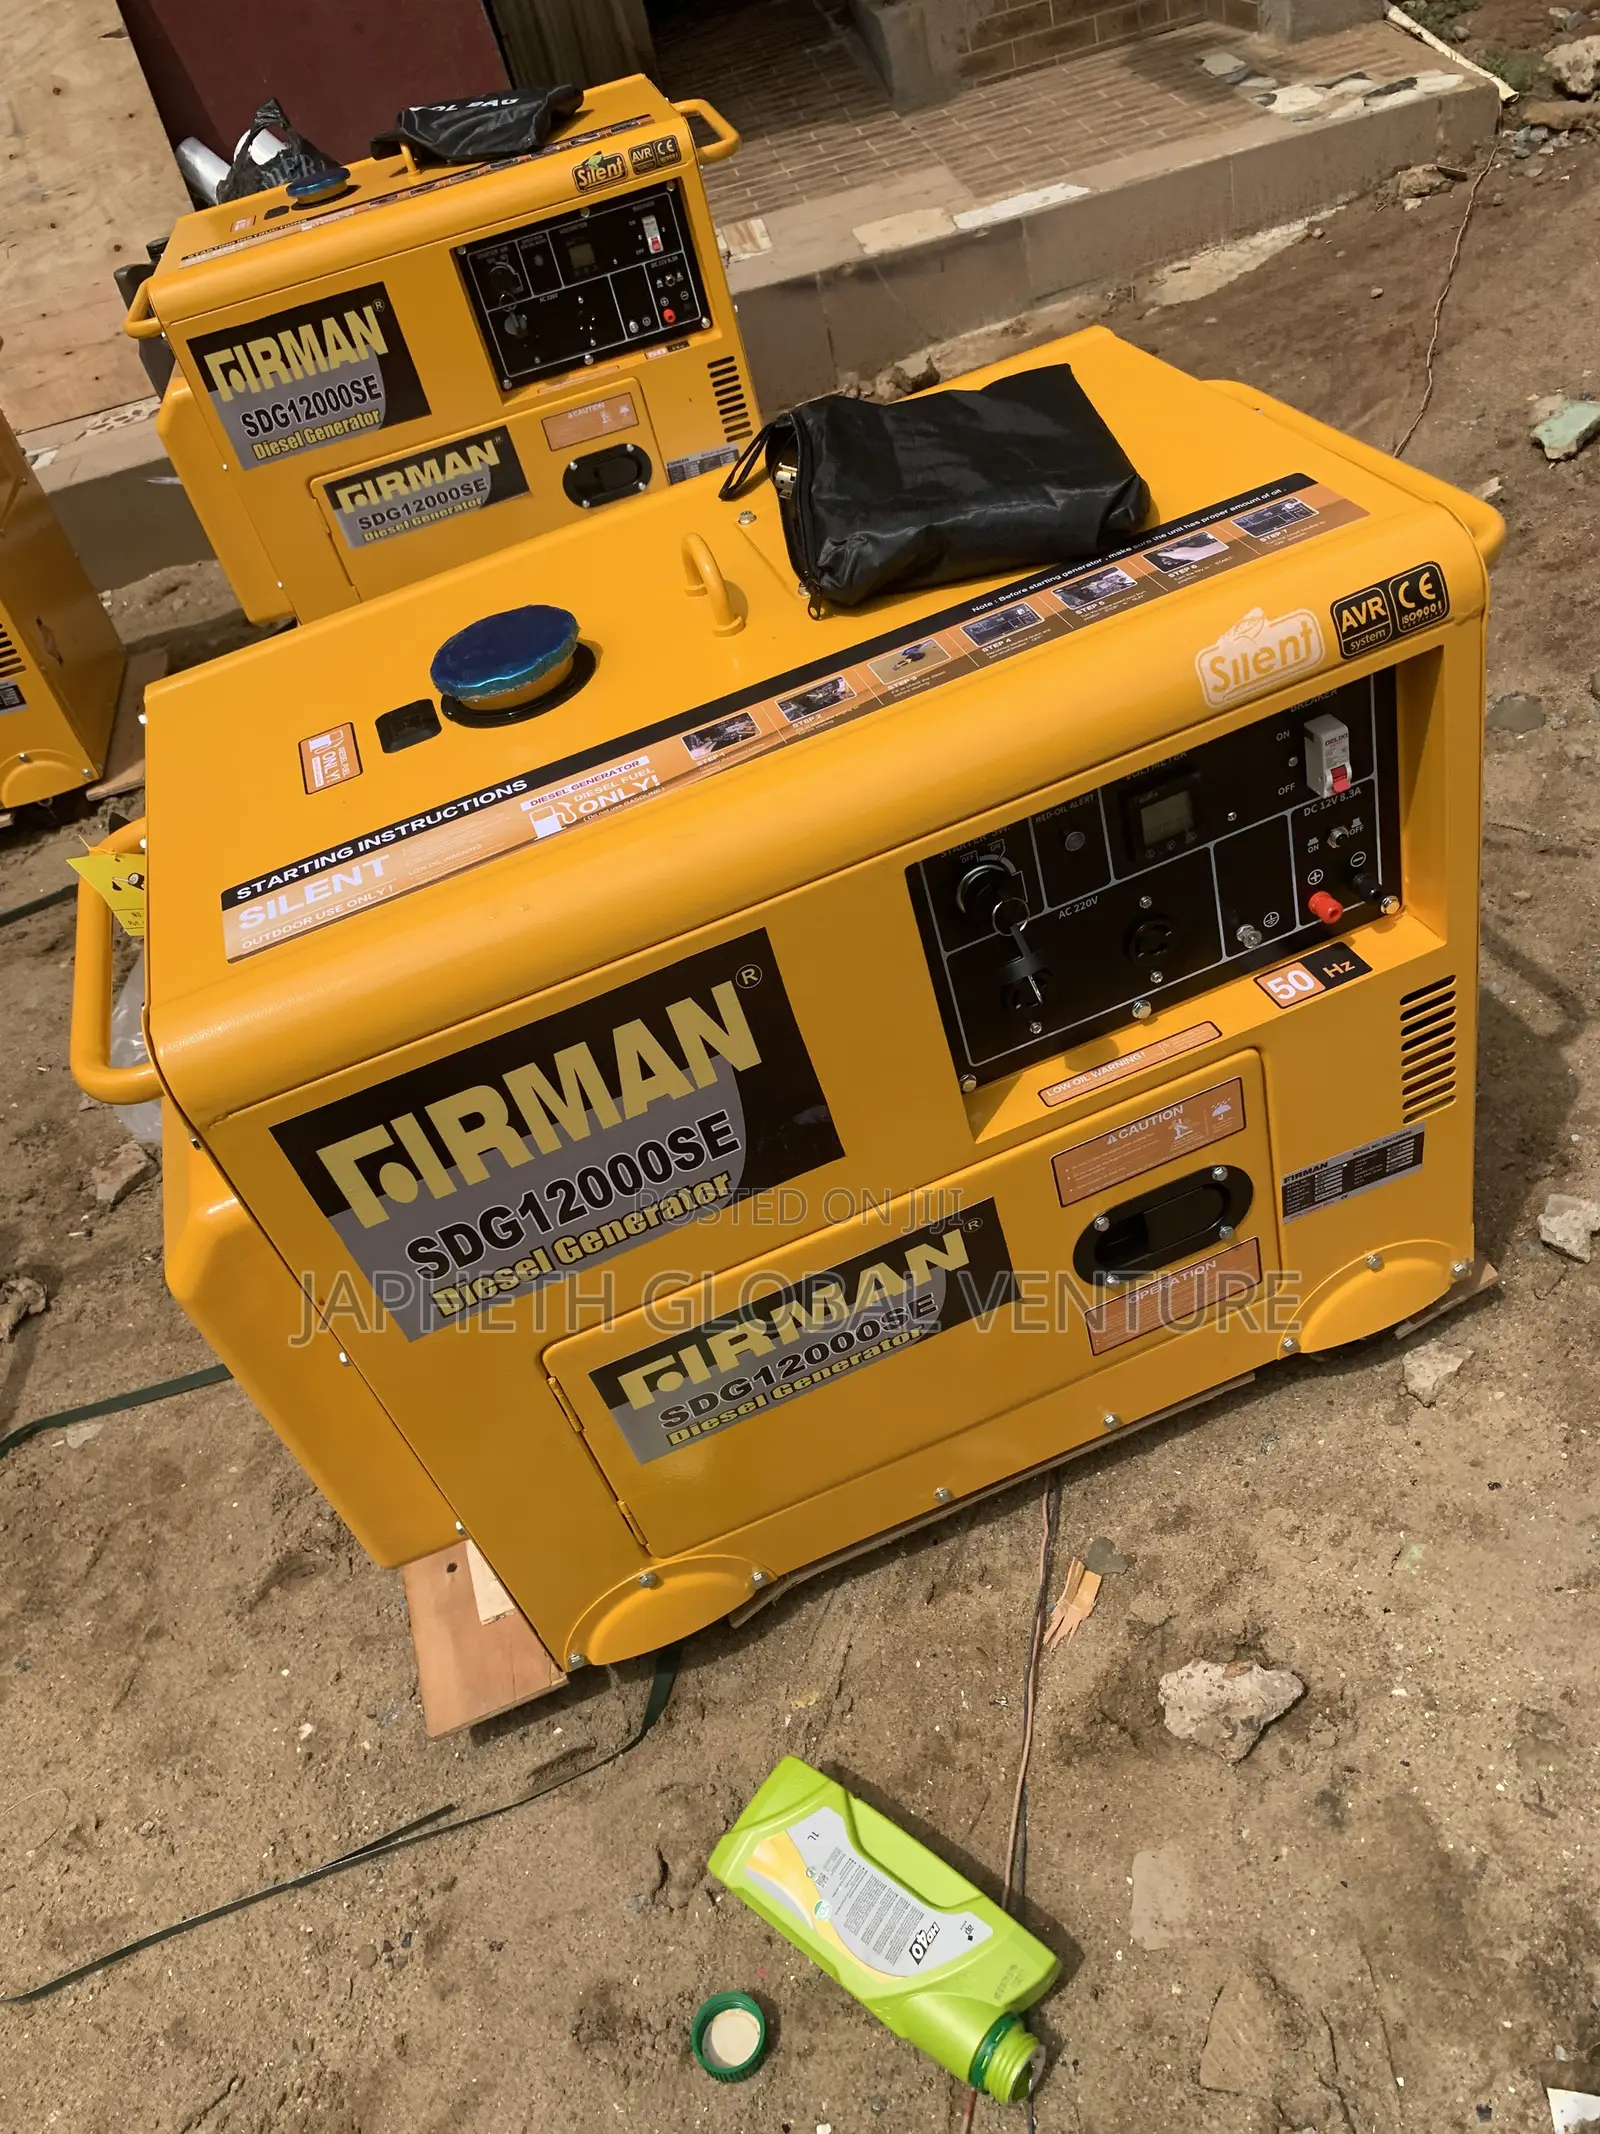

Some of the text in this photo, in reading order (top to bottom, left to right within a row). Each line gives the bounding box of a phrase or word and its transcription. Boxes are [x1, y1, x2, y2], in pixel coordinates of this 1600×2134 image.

[632, 148, 652, 162] AVR
[658, 140, 674, 155] CE
[578, 157, 622, 186] Silent
[204, 305, 389, 402] FIRMAN
[241, 374, 383, 438] SDG12000SE
[252, 408, 381, 460] Diesel Generator
[335, 438, 500, 514] FIRMAN
[358, 478, 489, 532] SDG12000SE
[362, 496, 484, 544] Diesel Generator
[999, 585, 1026, 602] Before
[1028, 572, 1062, 592] starting
[1108, 548, 1131, 559] make
[1132, 540, 1152, 550] sure
[1152, 532, 1167, 542] the
[1168, 525, 1183, 536] unit
[1184, 520, 1200, 530] has
[1201, 509, 1229, 524] proper
[1230, 497, 1261, 512] amount
[1261, 491, 1270, 500] of
[1260, 531, 1281, 542] STEP
[1168, 566, 1190, 578] STEP
[1398, 572, 1436, 609] CE
[1076, 603, 1098, 615] STEP
[1342, 597, 1387, 633] AVR
[1401, 600, 1442, 626] ISO9001
[982, 641, 1004, 653] STEP
[1350, 629, 1386, 650] system
[1209, 620, 1315, 694] Silent
[887, 679, 910, 690] STEP
[792, 716, 814, 728] STEP
[1276, 730, 1290, 742] ON
[322, 751, 341, 783] ONLY!
[696, 754, 718, 766] STEP
[530, 760, 640, 807] DIESEL GENERATOR
[573, 768, 656, 802] DIESEL FUEL
[578, 774, 661, 814] ONLY!
[1277, 782, 1296, 796] OFF
[610, 804, 622, 813] use
[1035, 794, 1094, 823] RED-OIL ALERT
[1304, 786, 1362, 817] DC 12V 8.3A
[236, 844, 354, 900] STARTING
[358, 778, 528, 854] INSTRUCTIONS
[1350, 824, 1364, 835] OFF
[408, 844, 482, 876] LOW OIL WARNING
[960, 852, 976, 864] OFF
[1308, 843, 1320, 854] ON
[239, 854, 390, 931] SILENT
[1058, 895, 1099, 919] AC 220V
[242, 916, 312, 950] OUTDOOR
[315, 904, 345, 928] USE
[1266, 958, 1356, 1000] 50 Hz
[1046, 1080, 1072, 1098] LOW
[1072, 1074, 1090, 1088] OIL
[1091, 1051, 1146, 1079] WARNING!
[316, 980, 762, 1229] FIRMAN
[1118, 1105, 1184, 1140] CAUTION
[1284, 1162, 1328, 1184] FIRMAN
[405, 1110, 741, 1282] SDG12000SE
[428, 1170, 730, 1319] Diesel Generator
[1128, 1260, 1217, 1304] OPERATION
[617, 1228, 970, 1411] FIRMAN
[658, 1292, 939, 1429] SDG12000SE
[666, 1324, 926, 1447] Diesel Generator
[808, 1830, 820, 1842] 1L
